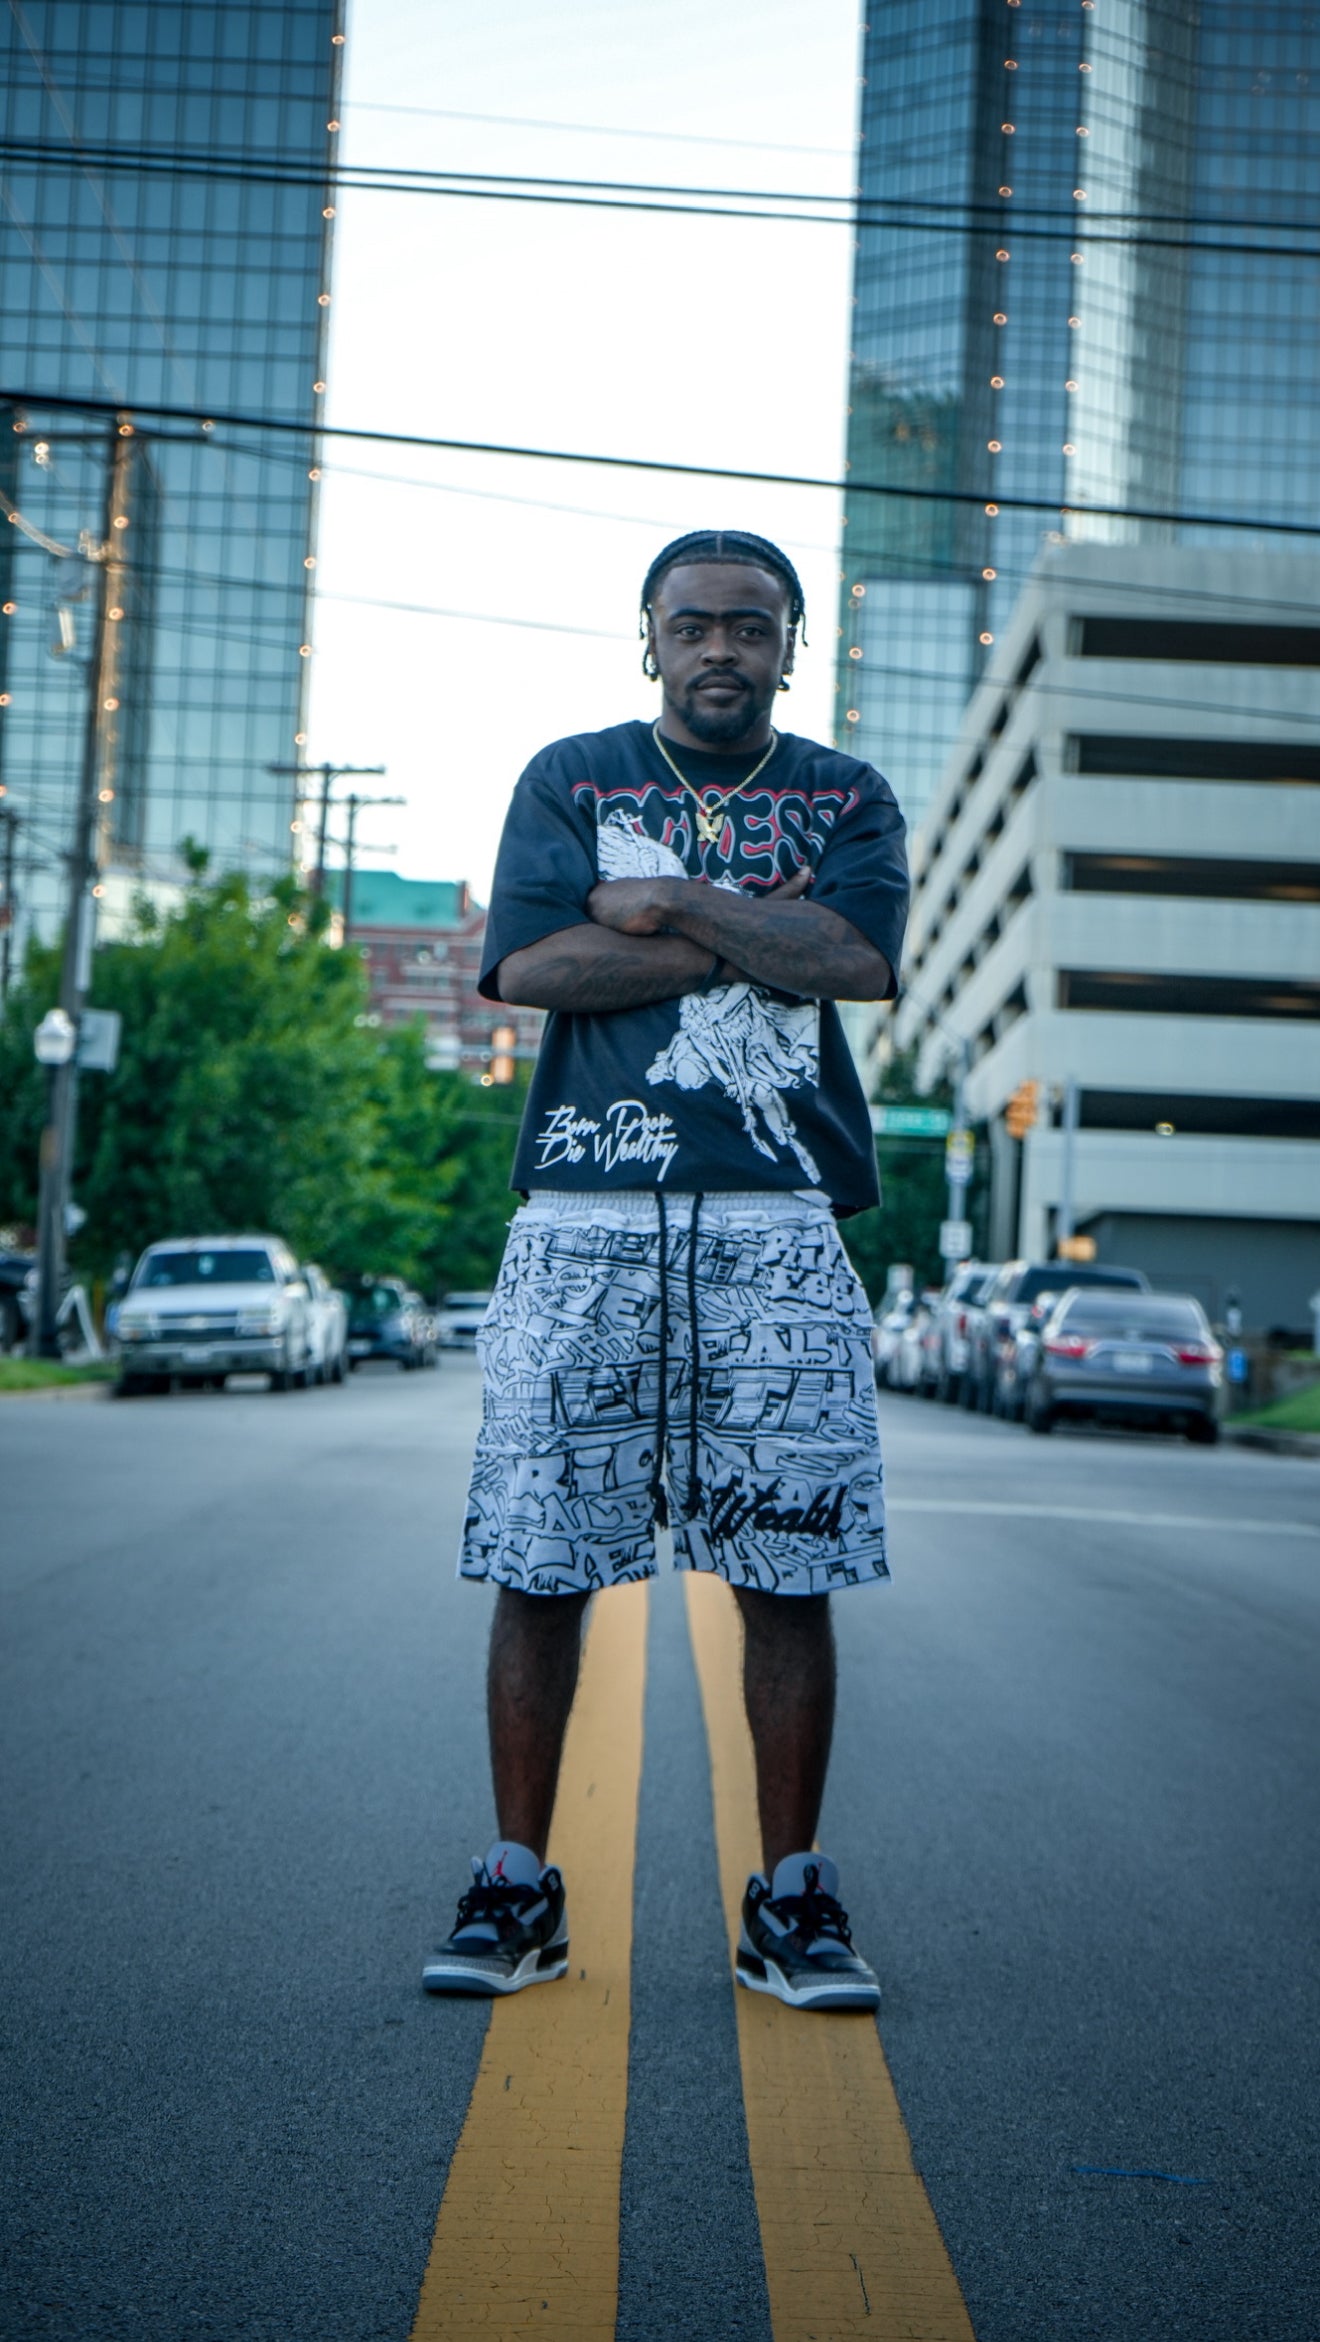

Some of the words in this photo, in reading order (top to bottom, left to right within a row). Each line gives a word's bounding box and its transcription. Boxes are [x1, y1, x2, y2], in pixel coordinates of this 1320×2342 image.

[538, 1104, 601, 1138] Born
[606, 1099, 674, 1138] Poor
[534, 1133, 586, 1169] Die
[594, 1122, 679, 1182] Wealthy
